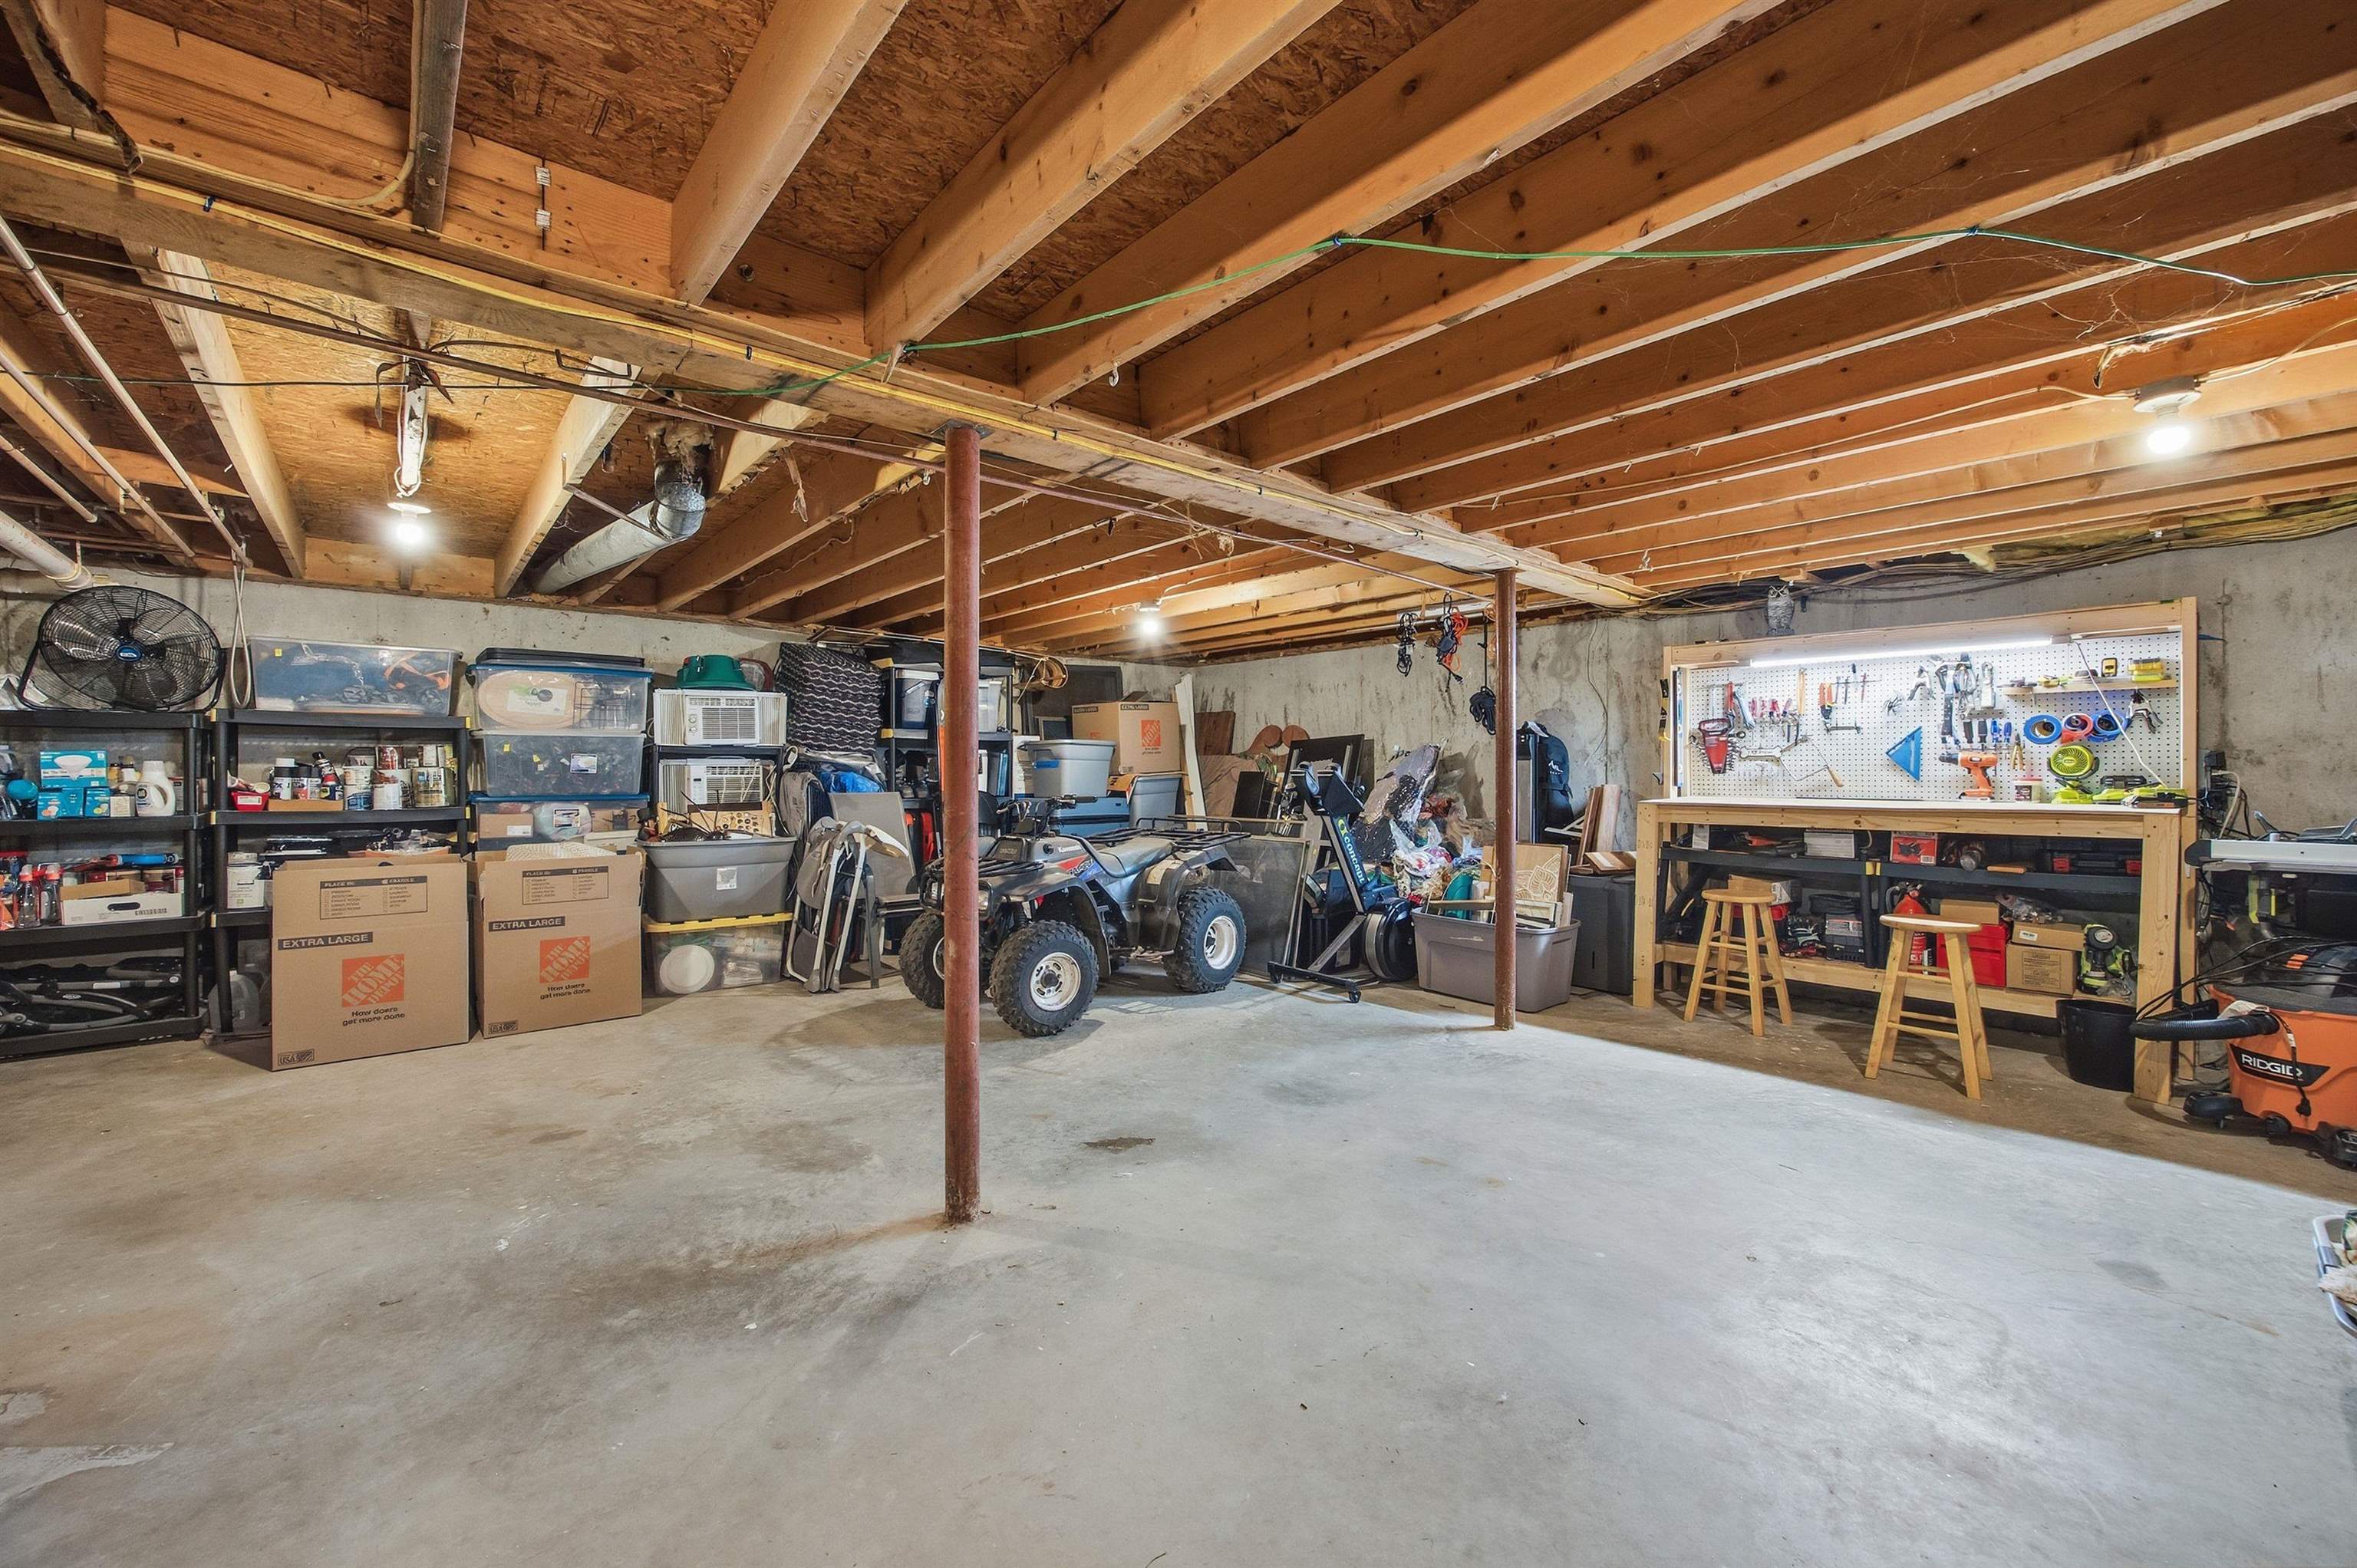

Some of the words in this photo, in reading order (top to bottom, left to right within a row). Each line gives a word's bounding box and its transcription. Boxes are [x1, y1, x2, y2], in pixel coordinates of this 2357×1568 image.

[493, 921, 526, 931] EXTRA
[529, 917, 562, 927] LARGE
[282, 937, 325, 949] EXTRA
[328, 933, 368, 944] LARGE
[540, 937, 589, 983] HOME
[342, 954, 404, 1006] HOME
[358, 1015, 381, 1024] more
[2241, 1053, 2303, 1078] RIDGID
